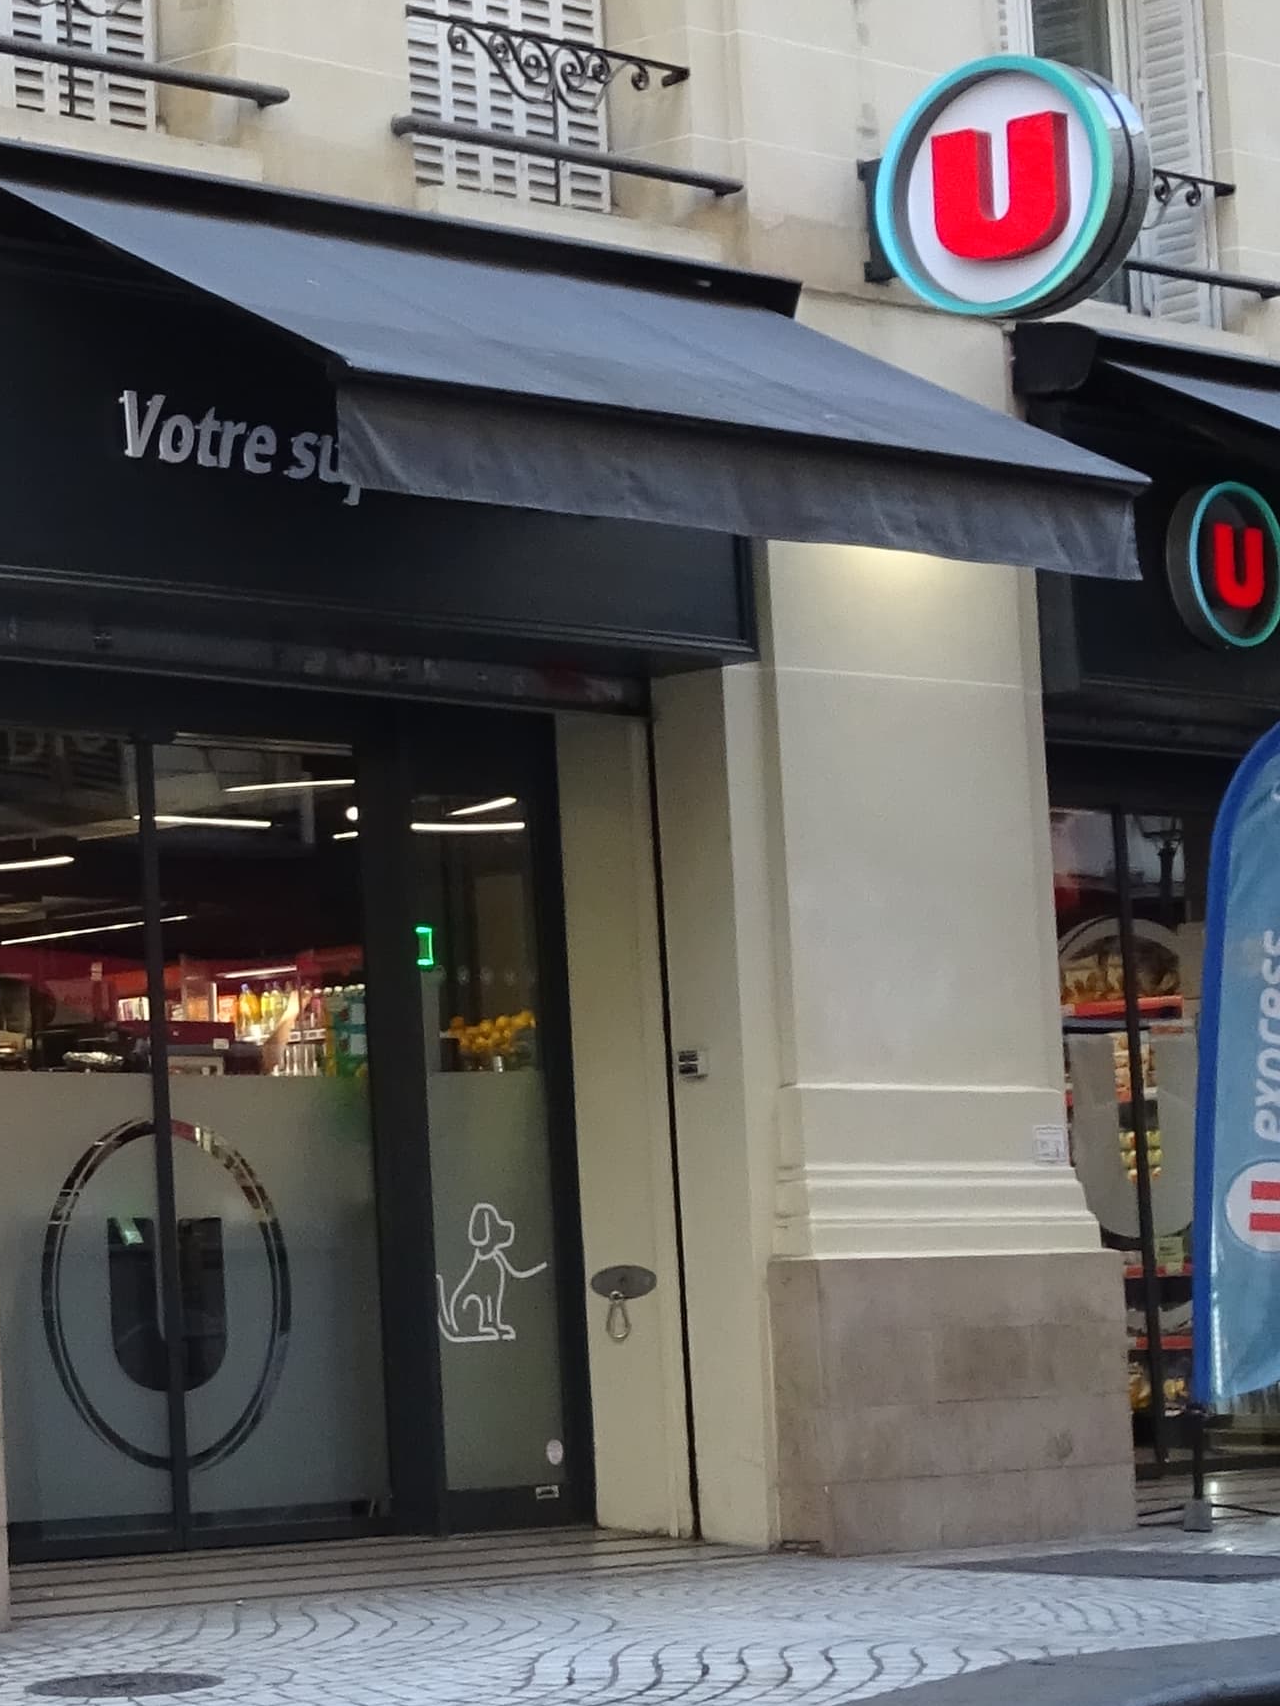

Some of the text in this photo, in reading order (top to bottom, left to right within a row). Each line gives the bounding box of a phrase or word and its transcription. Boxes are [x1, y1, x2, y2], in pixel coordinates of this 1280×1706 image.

[930, 110, 1072, 261] U
[119, 390, 362, 507] Votre su
[1212, 522, 1266, 610] U
